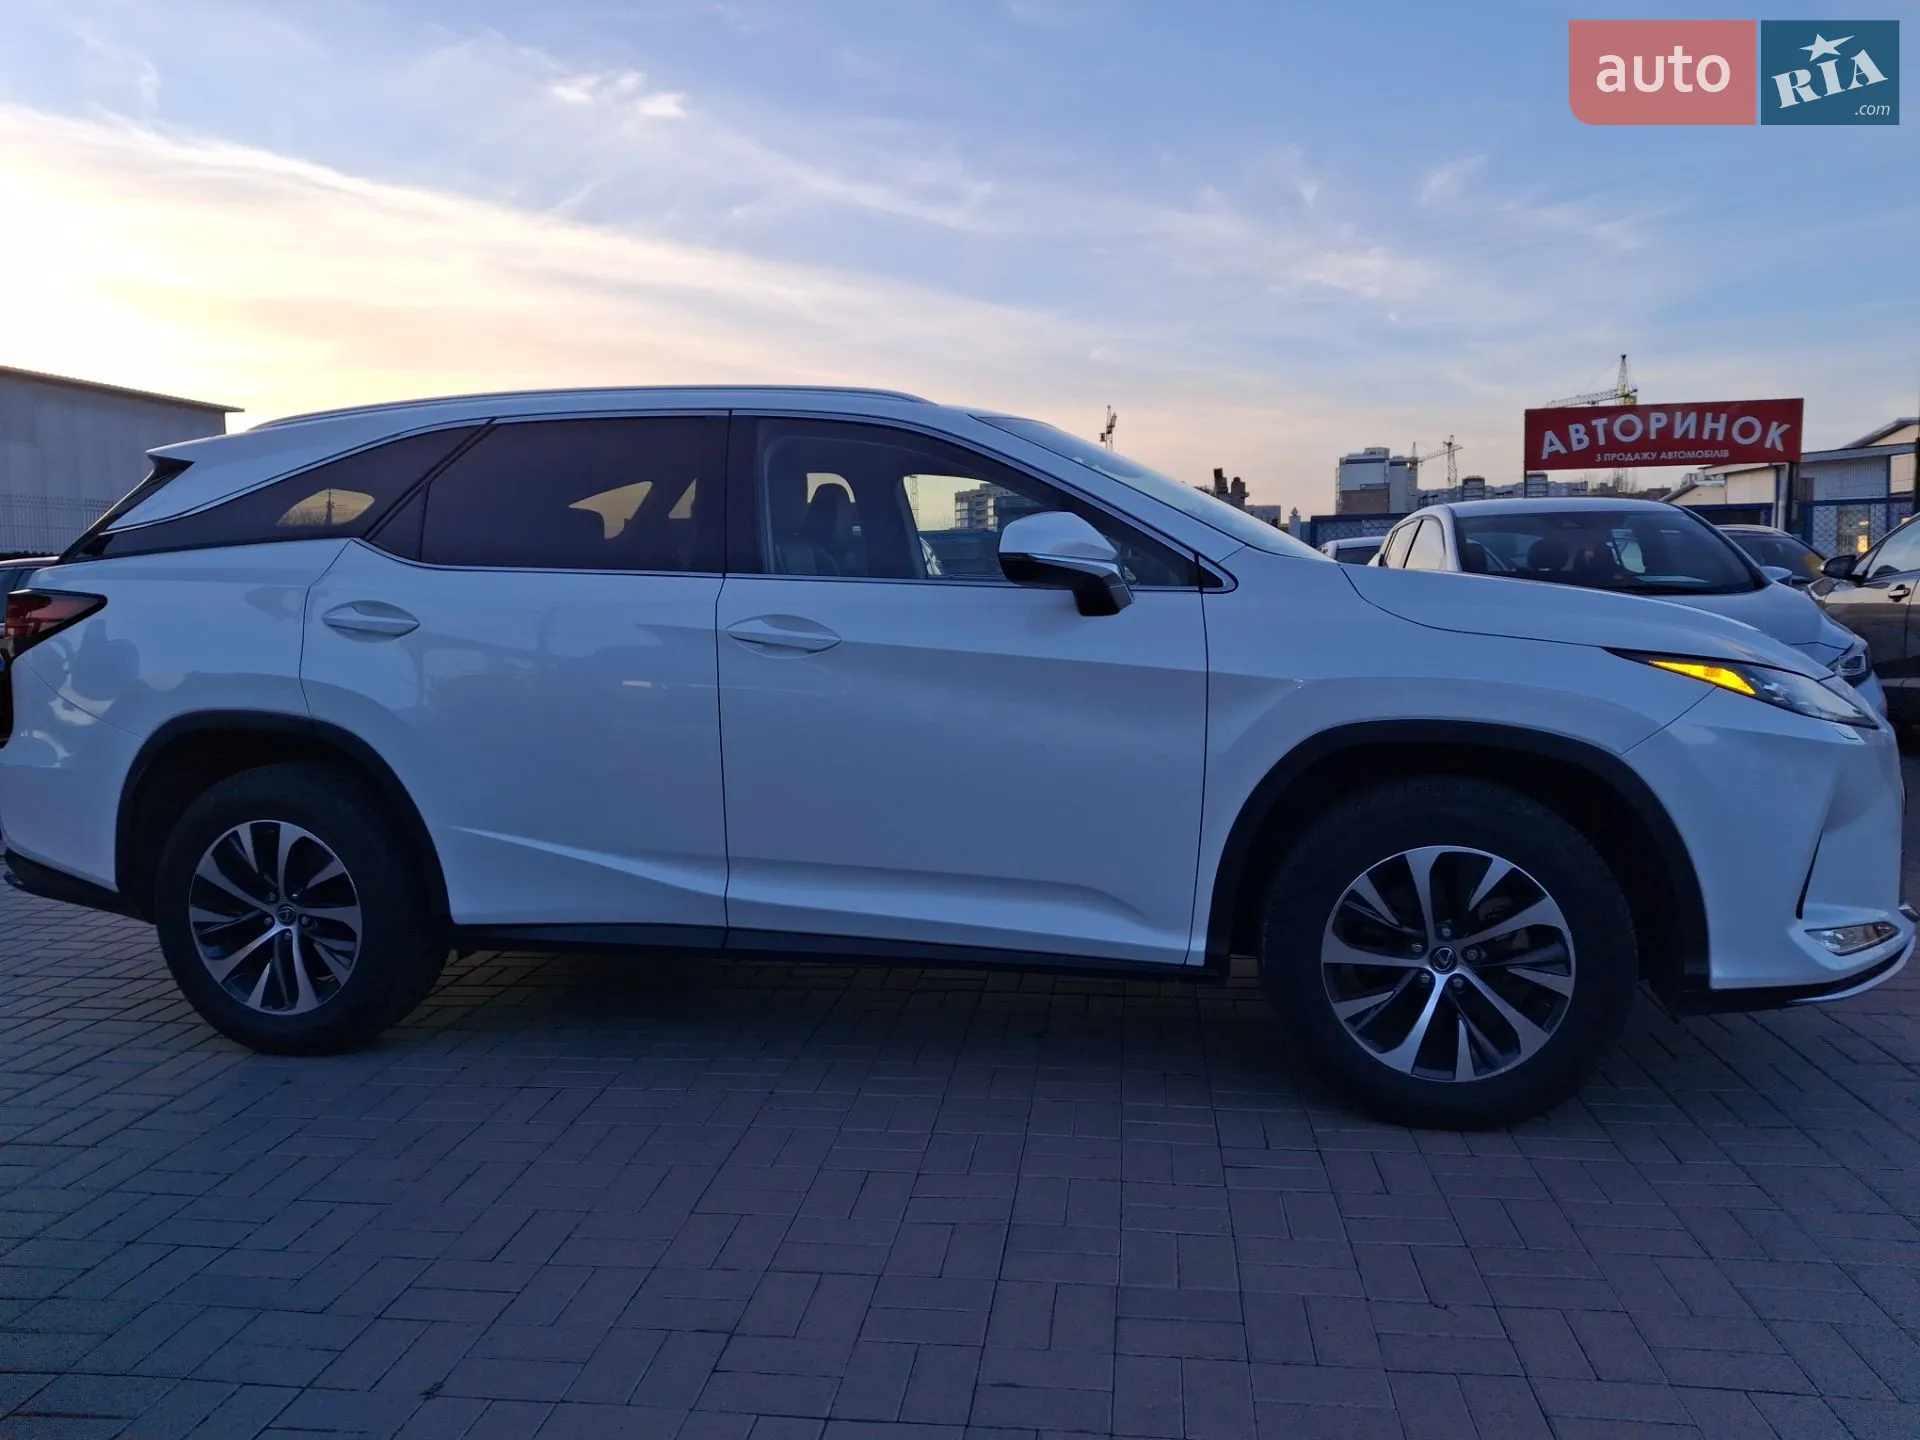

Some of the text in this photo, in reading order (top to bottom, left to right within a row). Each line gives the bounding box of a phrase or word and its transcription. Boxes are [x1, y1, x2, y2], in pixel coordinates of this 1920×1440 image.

[1541, 411, 1791, 460] АВТОРИНОК
[1604, 452, 1658, 462] ПРОДАЖУ
[1659, 449, 1730, 460] АВТОМОБІЛІВ
